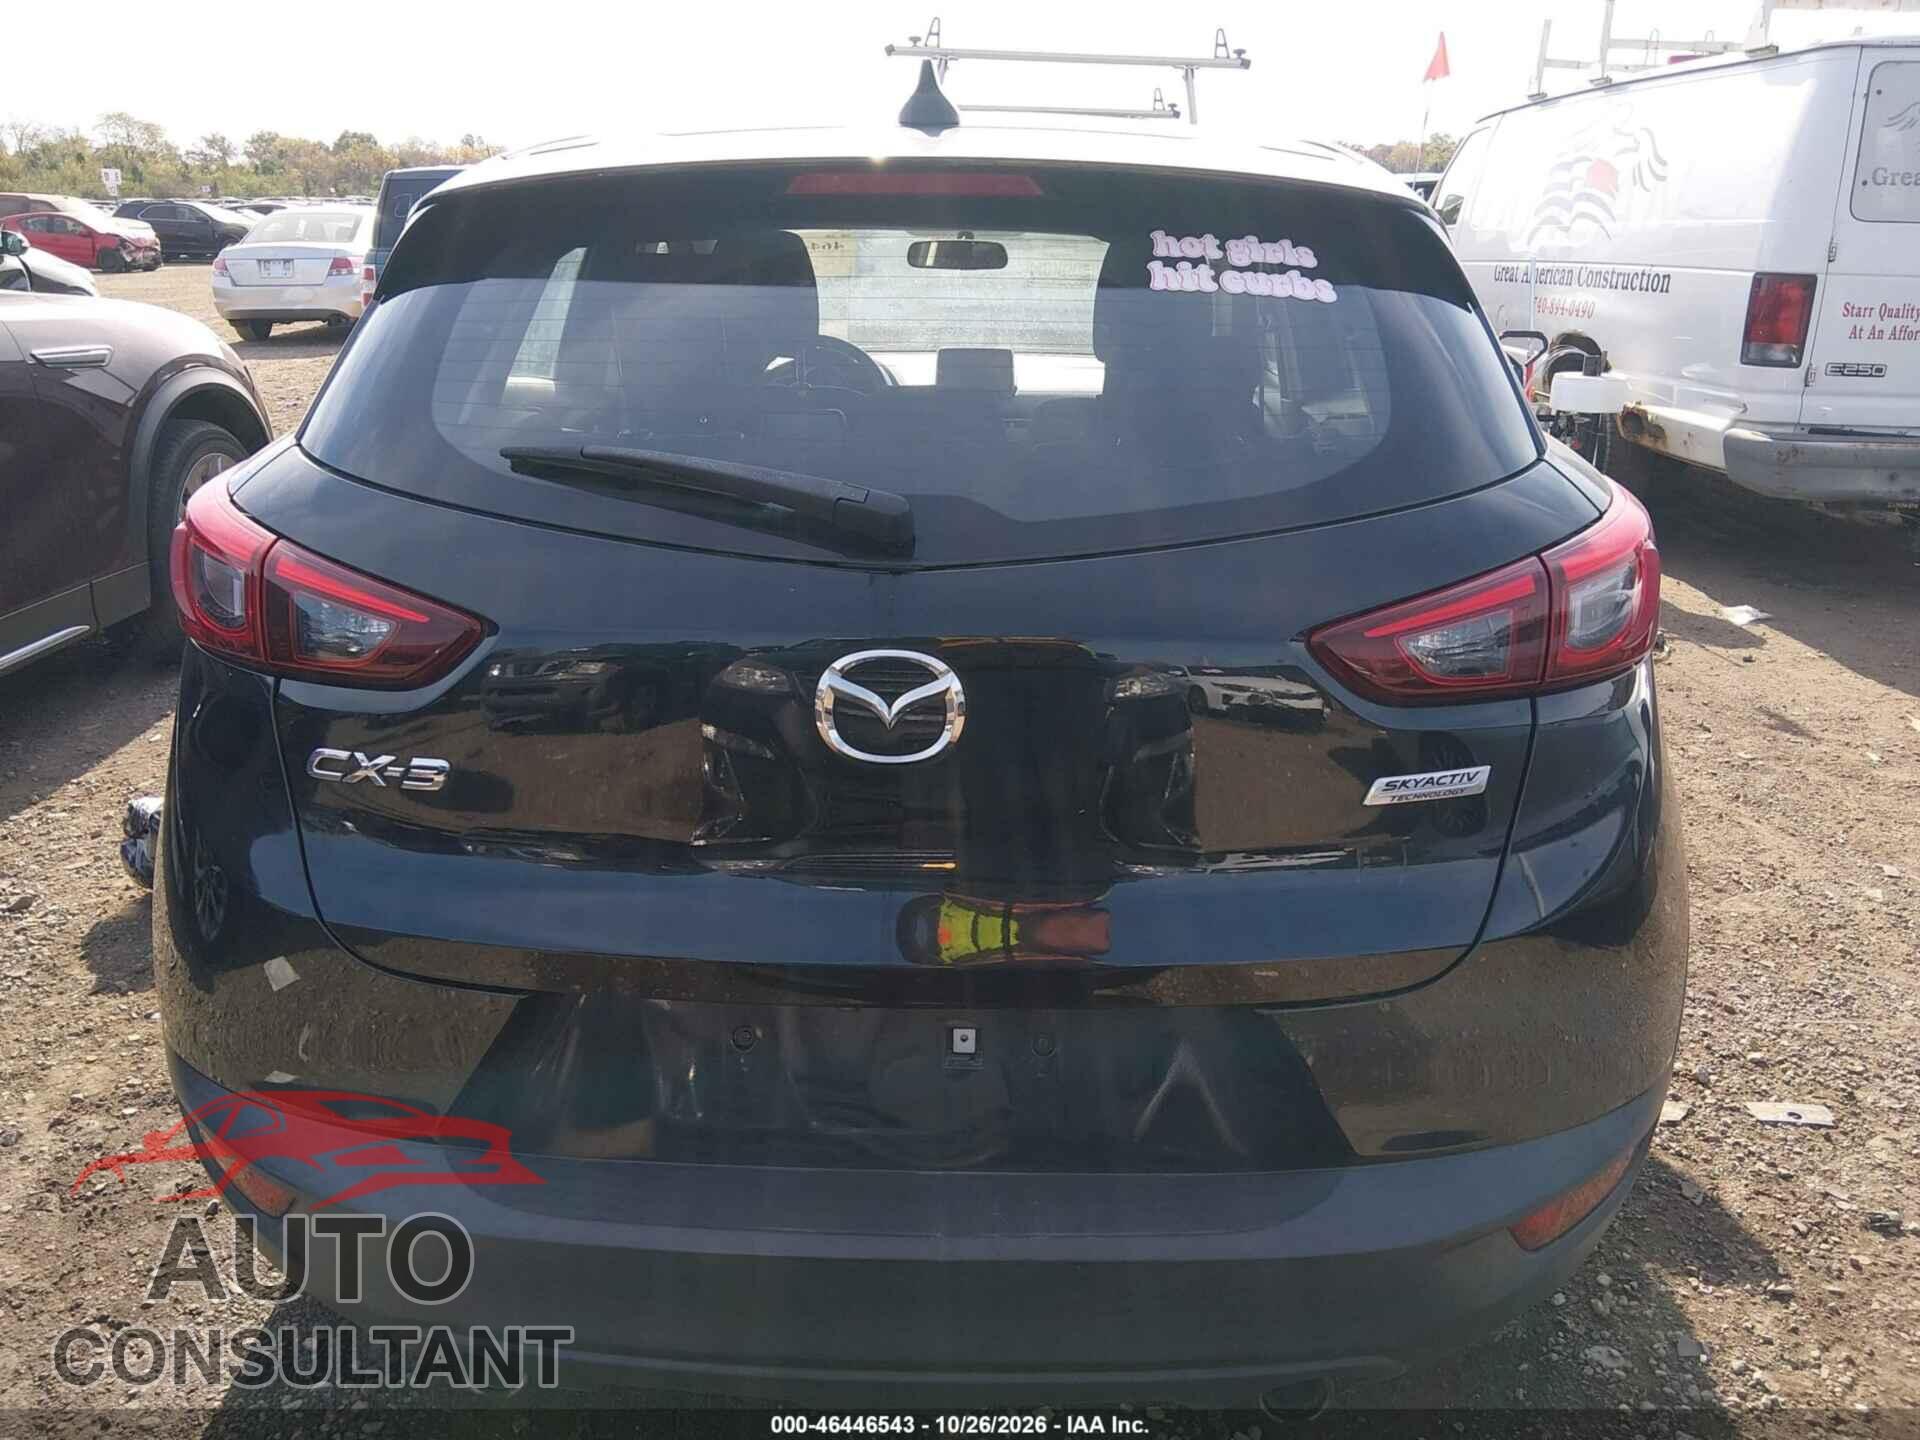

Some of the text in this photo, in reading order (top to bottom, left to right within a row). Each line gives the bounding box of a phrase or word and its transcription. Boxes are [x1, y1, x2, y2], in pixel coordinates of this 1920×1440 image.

[1150, 230, 1318, 268] hot girls
[1147, 260, 1338, 303] hit curbs
[1494, 264, 1519, 283] Great
[1577, 266, 1672, 294] Construction
[1842, 302, 1920, 322] Starr Quality
[1848, 324, 1864, 340] At
[1867, 324, 1884, 340] An
[306, 748, 450, 791] CX-3
[1381, 770, 1481, 792] SKYACTIV
